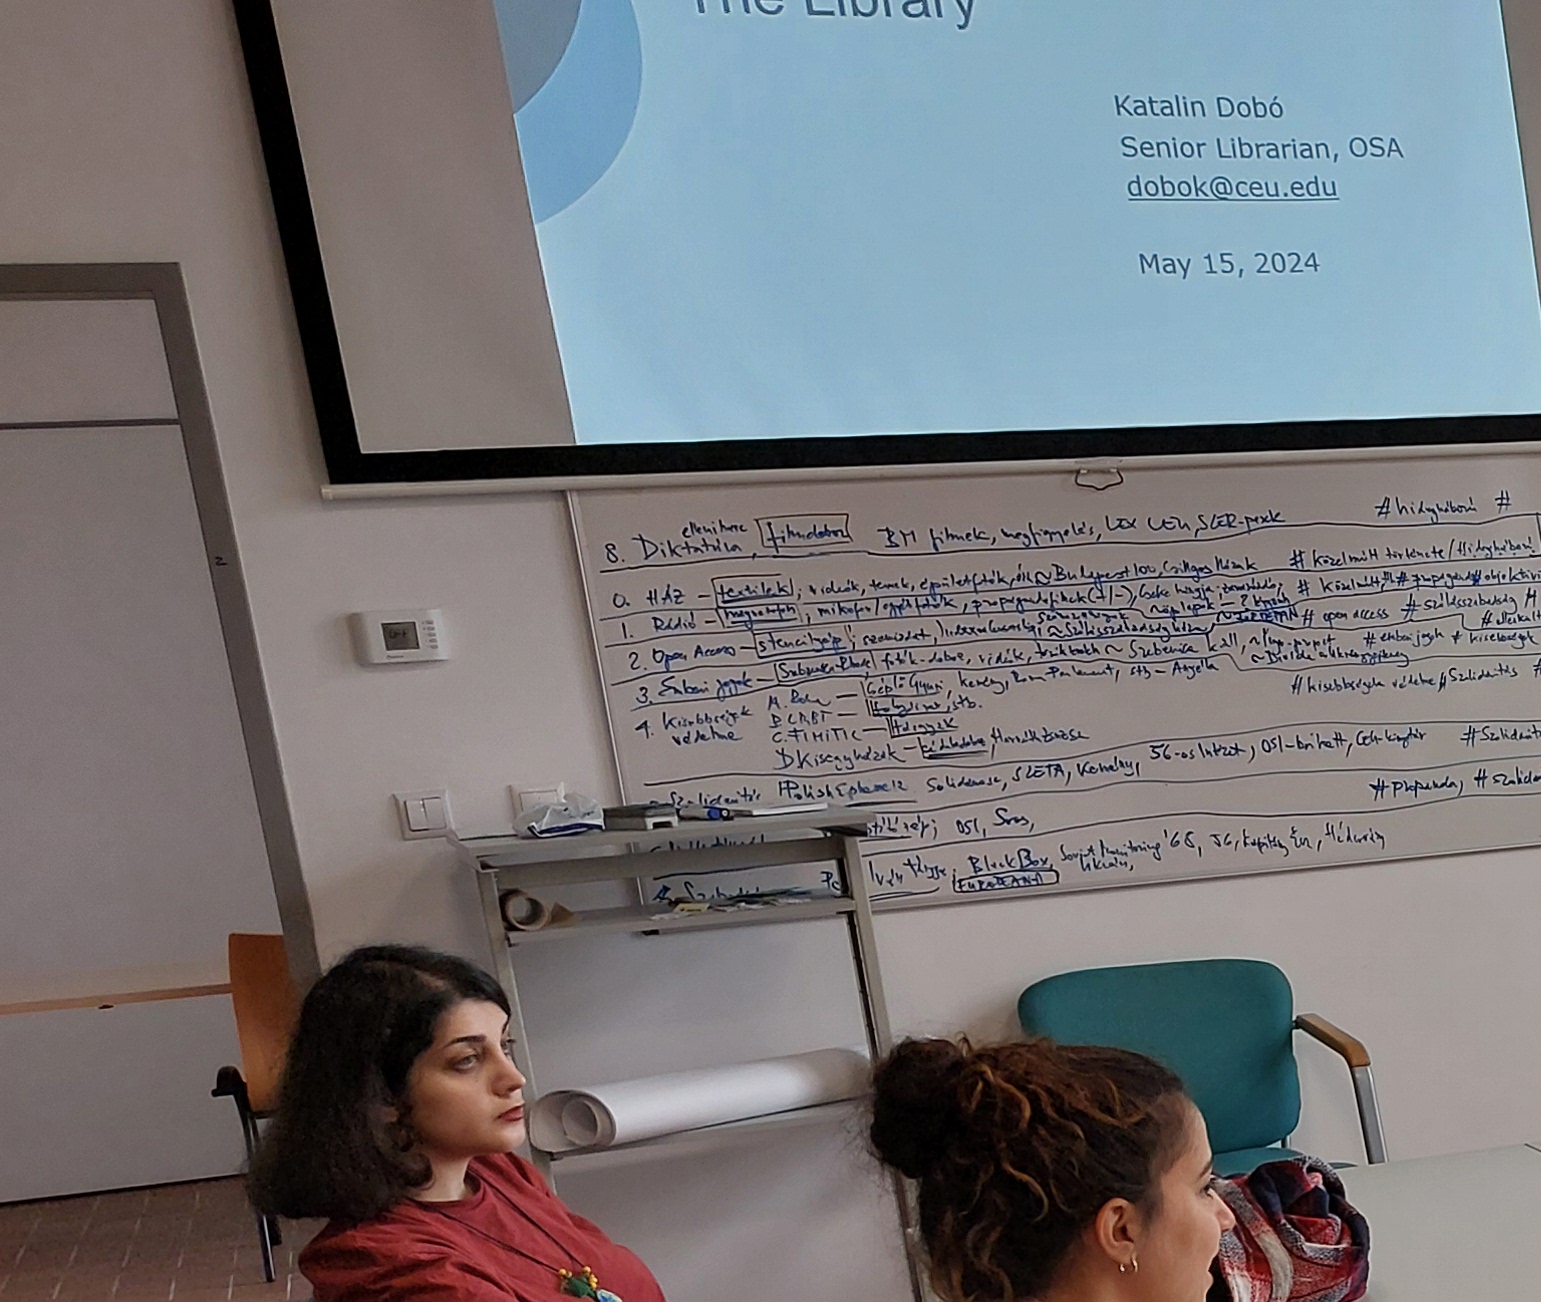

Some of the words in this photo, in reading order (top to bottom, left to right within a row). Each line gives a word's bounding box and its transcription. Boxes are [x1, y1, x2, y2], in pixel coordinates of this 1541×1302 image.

[1114, 95, 1206, 117] Katalin
[1216, 96, 1284, 118] Dobó
[1121, 136, 1207, 158] Senior
[1216, 137, 1339, 163] Librarian,
[1349, 137, 1404, 158] OSA
[1127, 175, 1340, 201] dobok@ceu.edu
[1139, 253, 1191, 279] May
[1203, 253, 1245, 278] 15,
[1254, 252, 1320, 274] 2024
